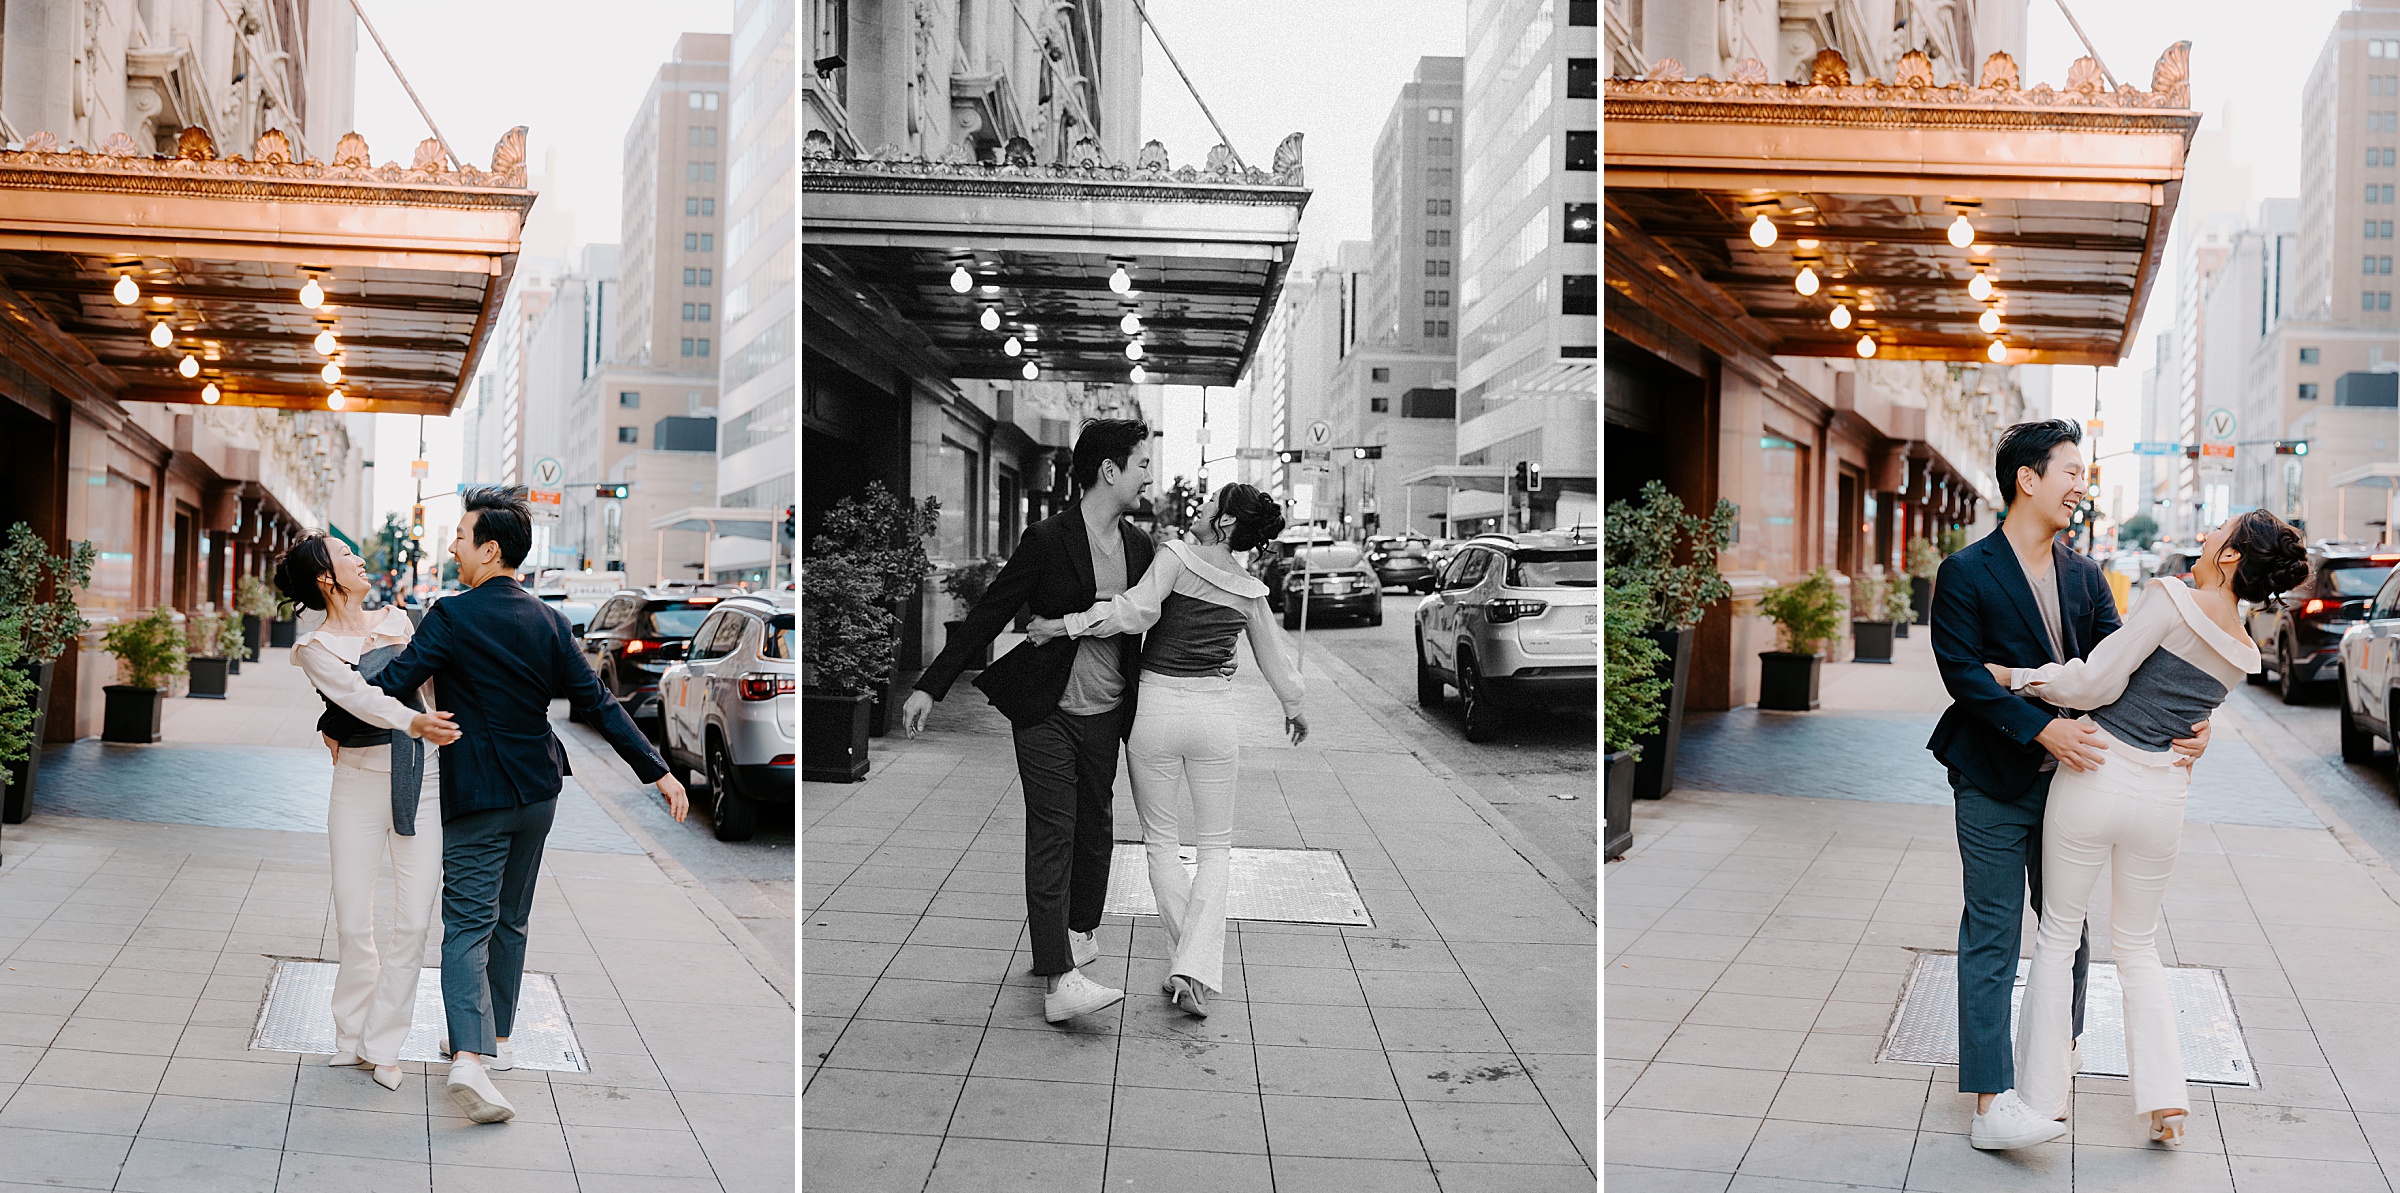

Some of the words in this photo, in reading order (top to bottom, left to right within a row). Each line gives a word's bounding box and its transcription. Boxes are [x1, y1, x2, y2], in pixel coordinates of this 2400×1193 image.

[2214, 416, 2229, 434] V
[1313, 427, 1326, 442] V
[541, 464, 556, 482] V
